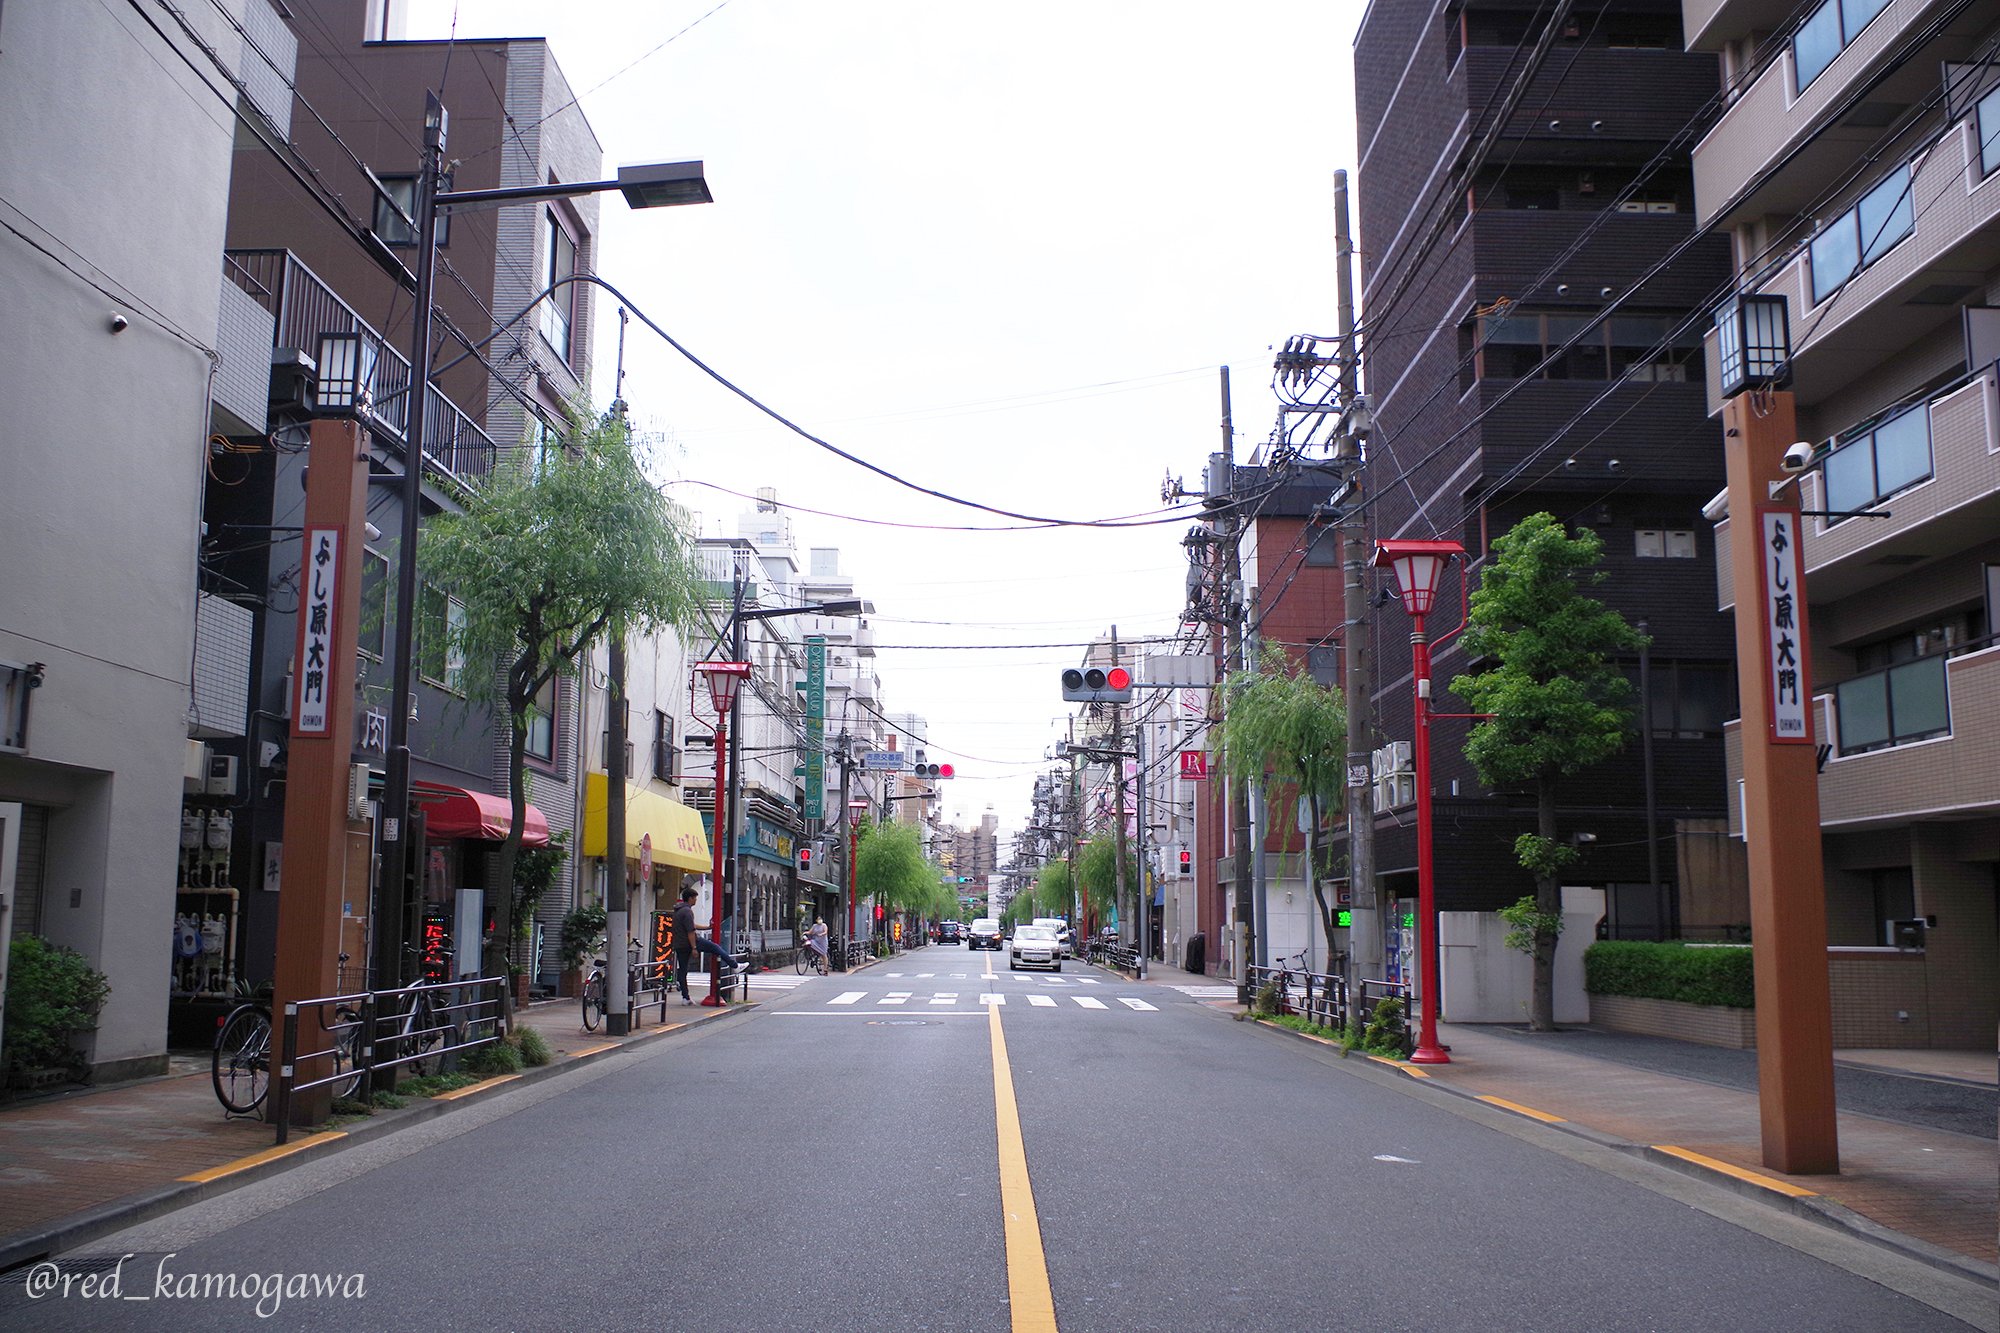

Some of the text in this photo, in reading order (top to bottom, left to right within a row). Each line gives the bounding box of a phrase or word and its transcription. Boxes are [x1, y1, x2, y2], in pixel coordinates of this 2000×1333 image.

[304, 535, 331, 704] よし原大門
[1771, 519, 1798, 706] よし原大門
[302, 714, 323, 727] OHMON
[361, 706, 387, 754] 肉
[1779, 718, 1803, 732] OHMON
[866, 753, 902, 761] 吉原交番前
